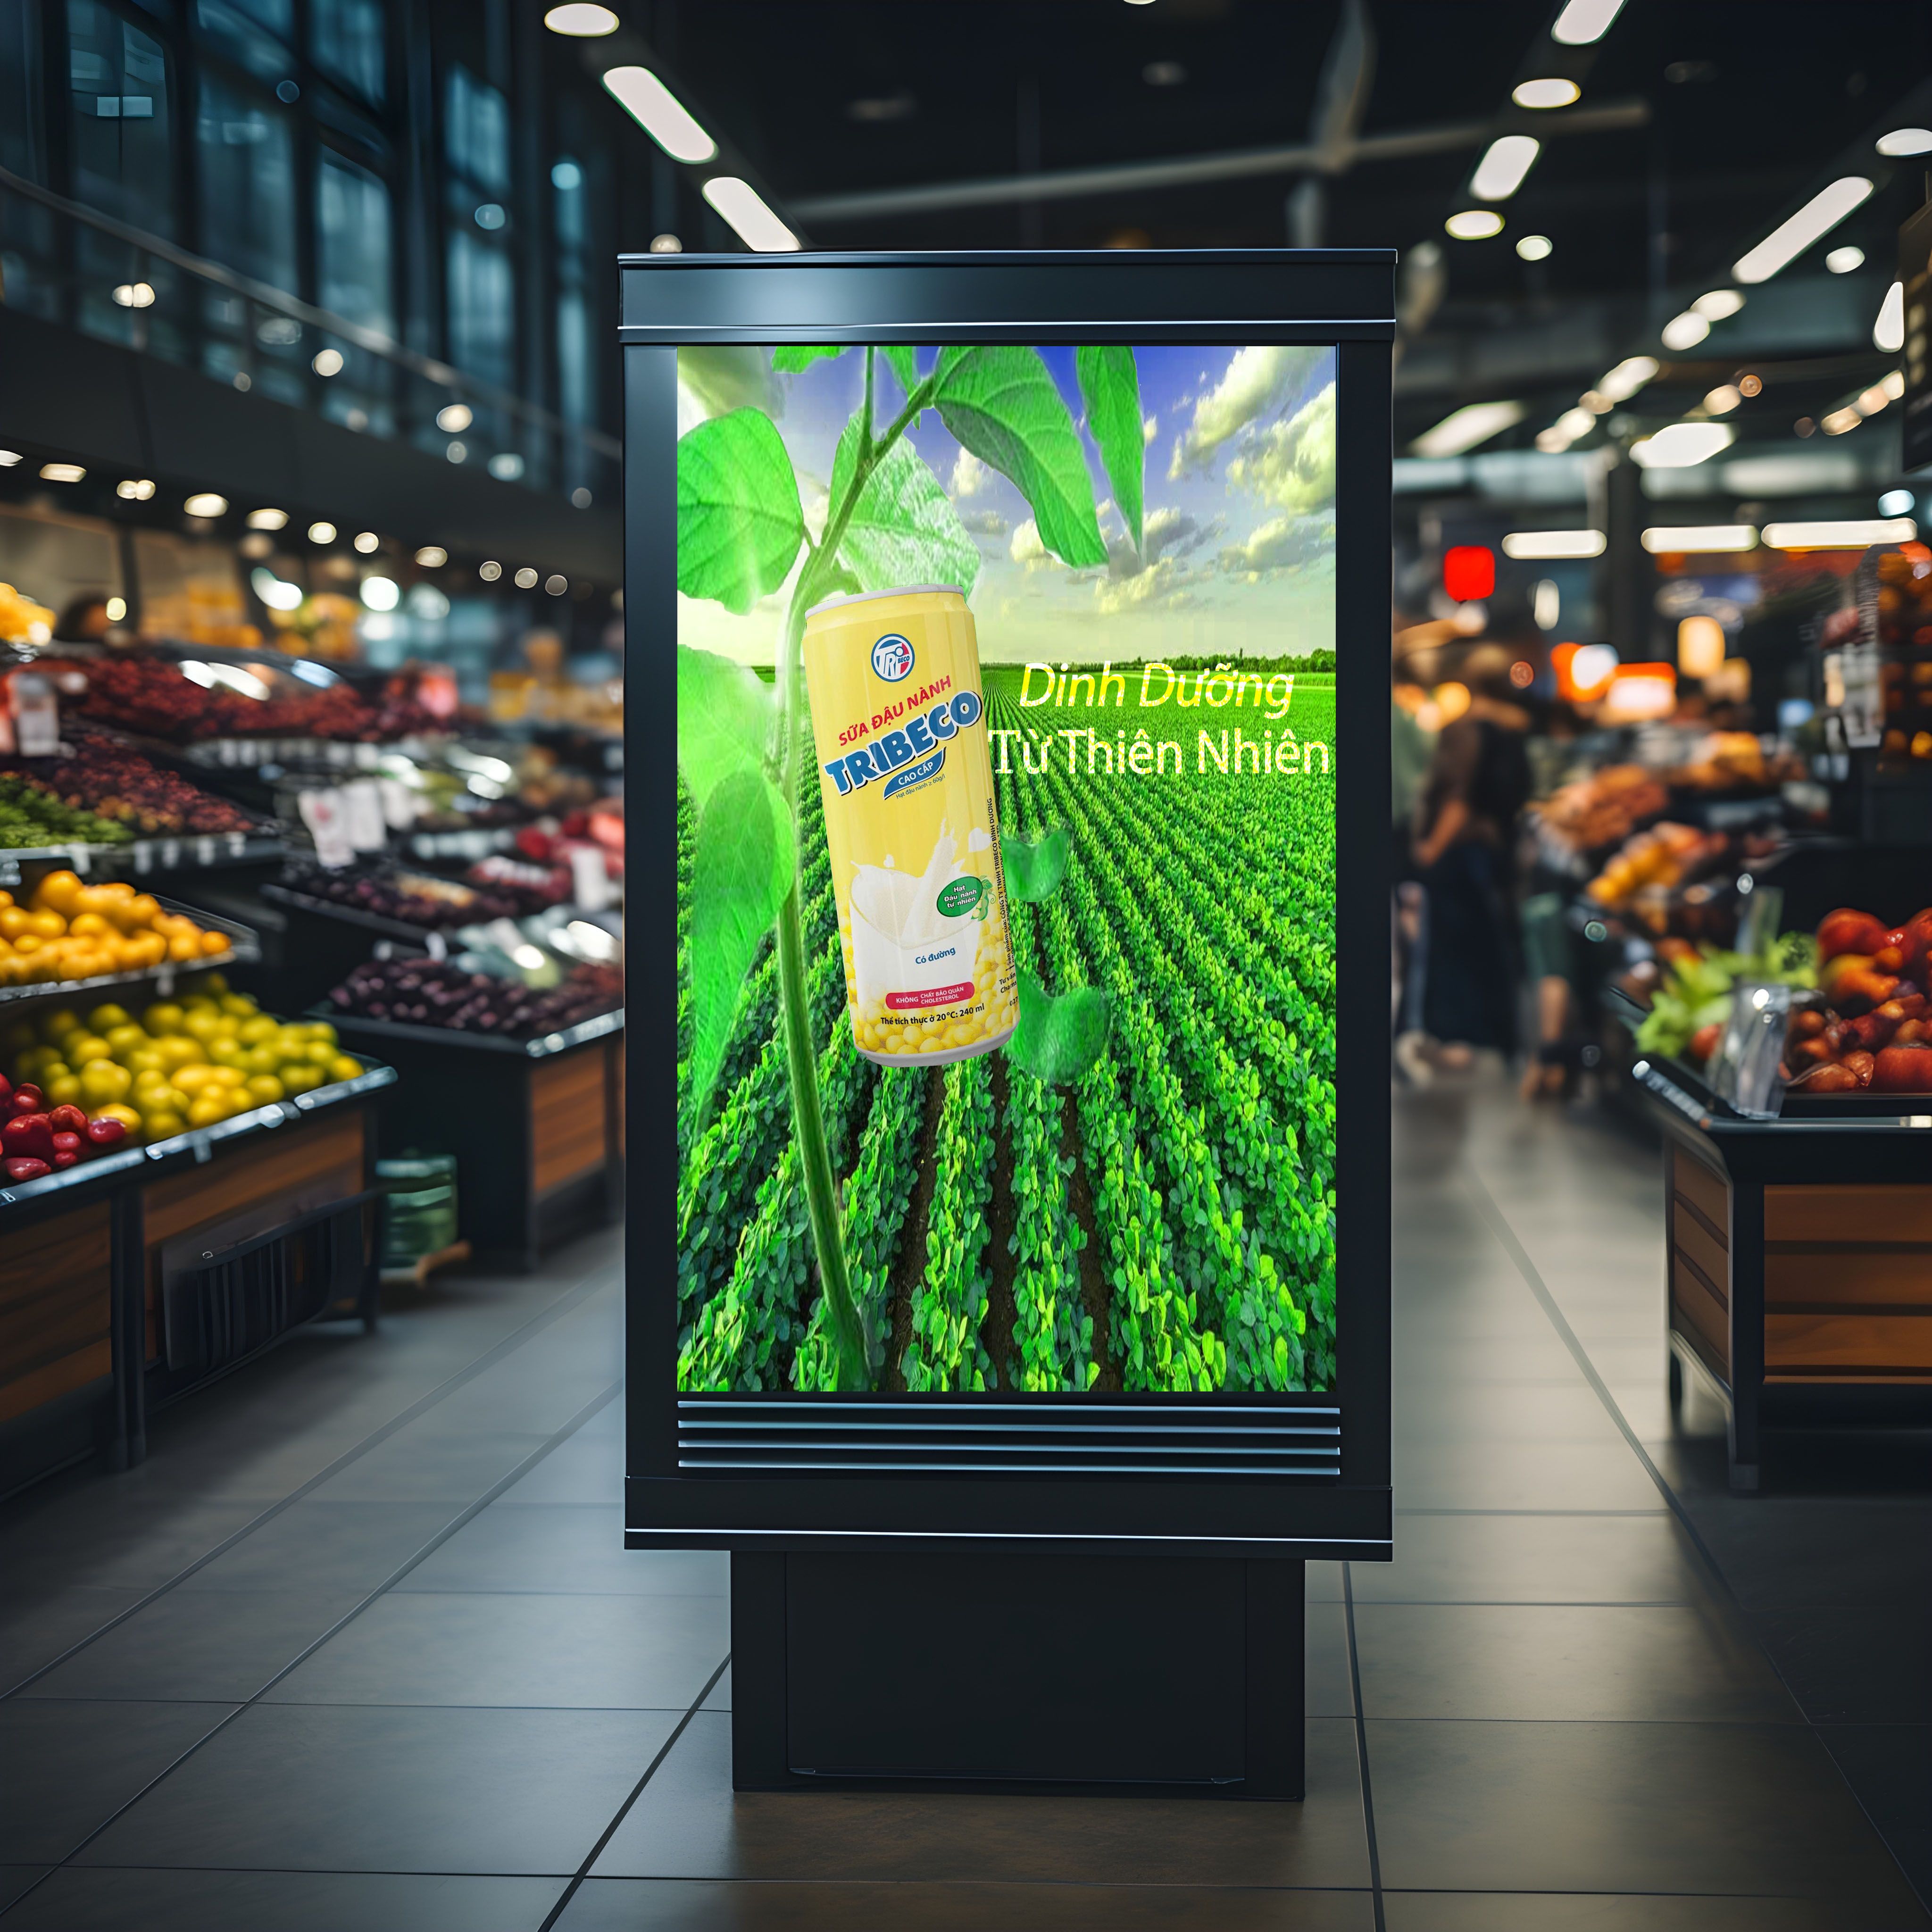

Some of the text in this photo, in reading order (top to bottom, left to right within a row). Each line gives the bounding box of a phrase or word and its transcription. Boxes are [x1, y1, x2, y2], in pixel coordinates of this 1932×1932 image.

[1019, 661, 1294, 720] Dinh Dưỡng
[839, 675, 951, 746] SỮA ĐẬU NÀNH
[823, 690, 982, 796] TRIBECO
[987, 728, 1329, 774] Từ Thiên Nhiên
[898, 762, 933, 785] CAO CẤP
[916, 783, 928, 791] nành
[957, 897, 975, 905] nhiên
[960, 889, 977, 898] nành
[998, 891, 1003, 899] TY
[915, 947, 956, 964] Có đường
[921, 993, 959, 1004] CHOLESTEROL
[948, 986, 964, 994] QUẢN
[881, 1016, 893, 1024] Thể
[910, 1016, 928, 1025] thực
[959, 1008, 973, 1016] 240
[975, 1003, 985, 1012] ml
